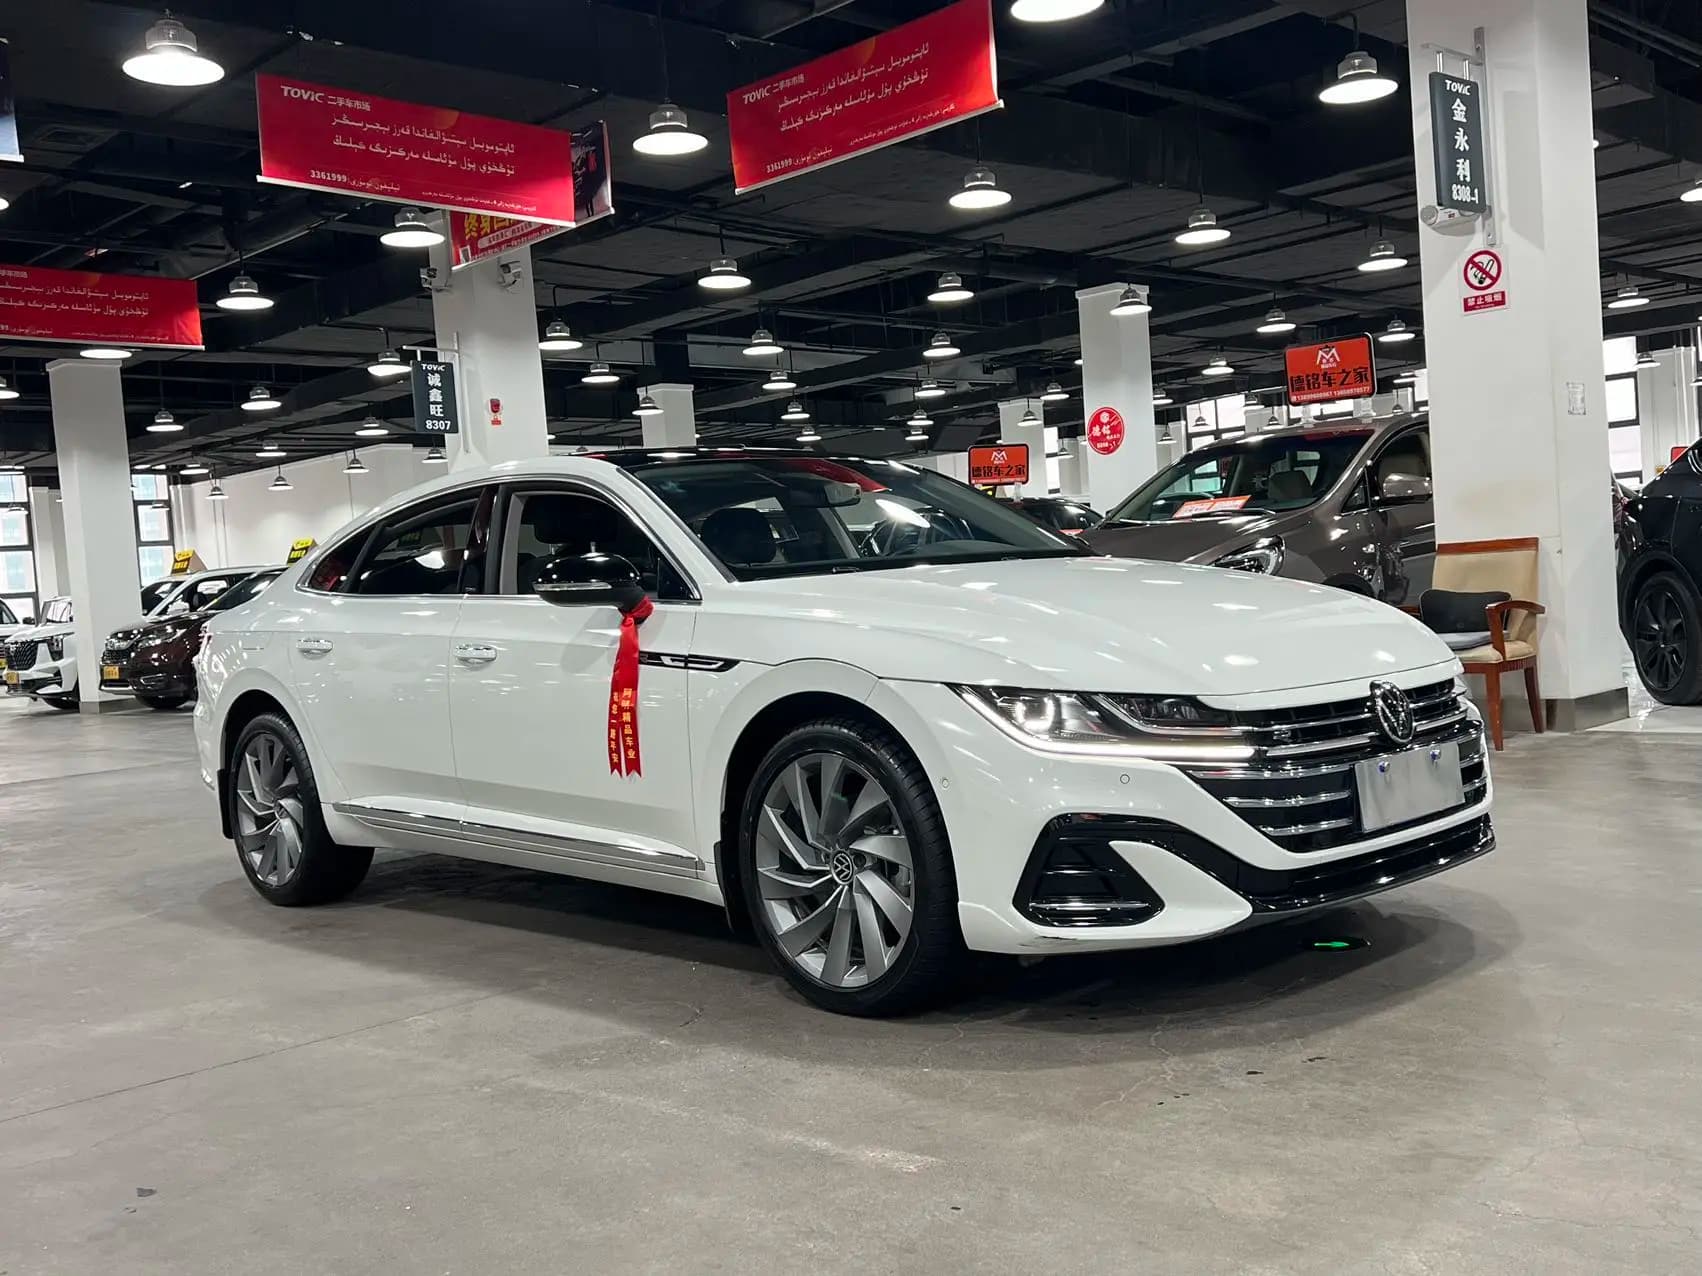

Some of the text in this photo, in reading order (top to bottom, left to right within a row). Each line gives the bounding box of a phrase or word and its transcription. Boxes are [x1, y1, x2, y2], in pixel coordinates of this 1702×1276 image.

[1451, 98, 1470, 182] 金永利
[766, 158, 792, 173] 3361999
[310, 169, 347, 183] 3361999
[1452, 184, 1479, 204] 8308-1
[425, 420, 451, 430] 8307
